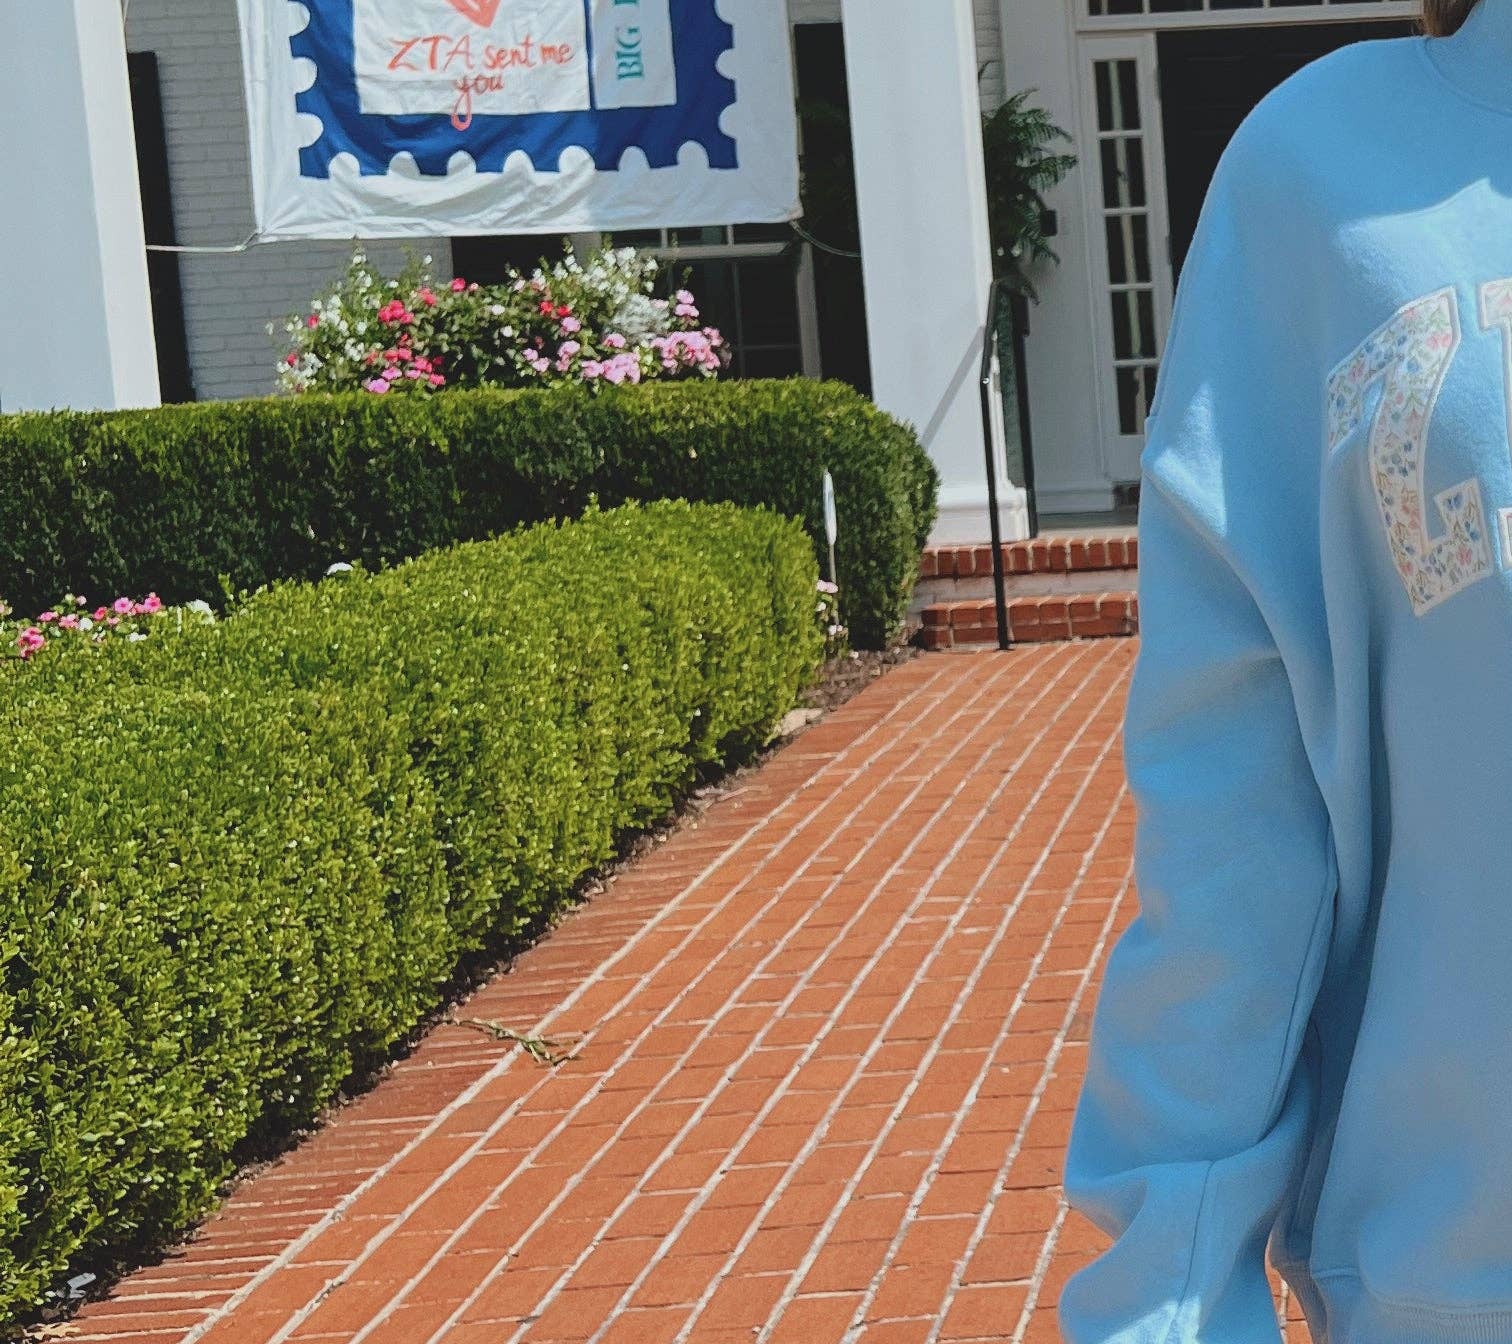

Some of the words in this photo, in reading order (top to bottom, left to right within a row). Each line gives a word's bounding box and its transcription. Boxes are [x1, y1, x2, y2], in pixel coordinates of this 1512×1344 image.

[387, 34, 474, 72] ZTA
[484, 32, 537, 70] sent
[540, 41, 575, 65] me
[615, 24, 644, 81] BIG
[451, 72, 505, 132] you
